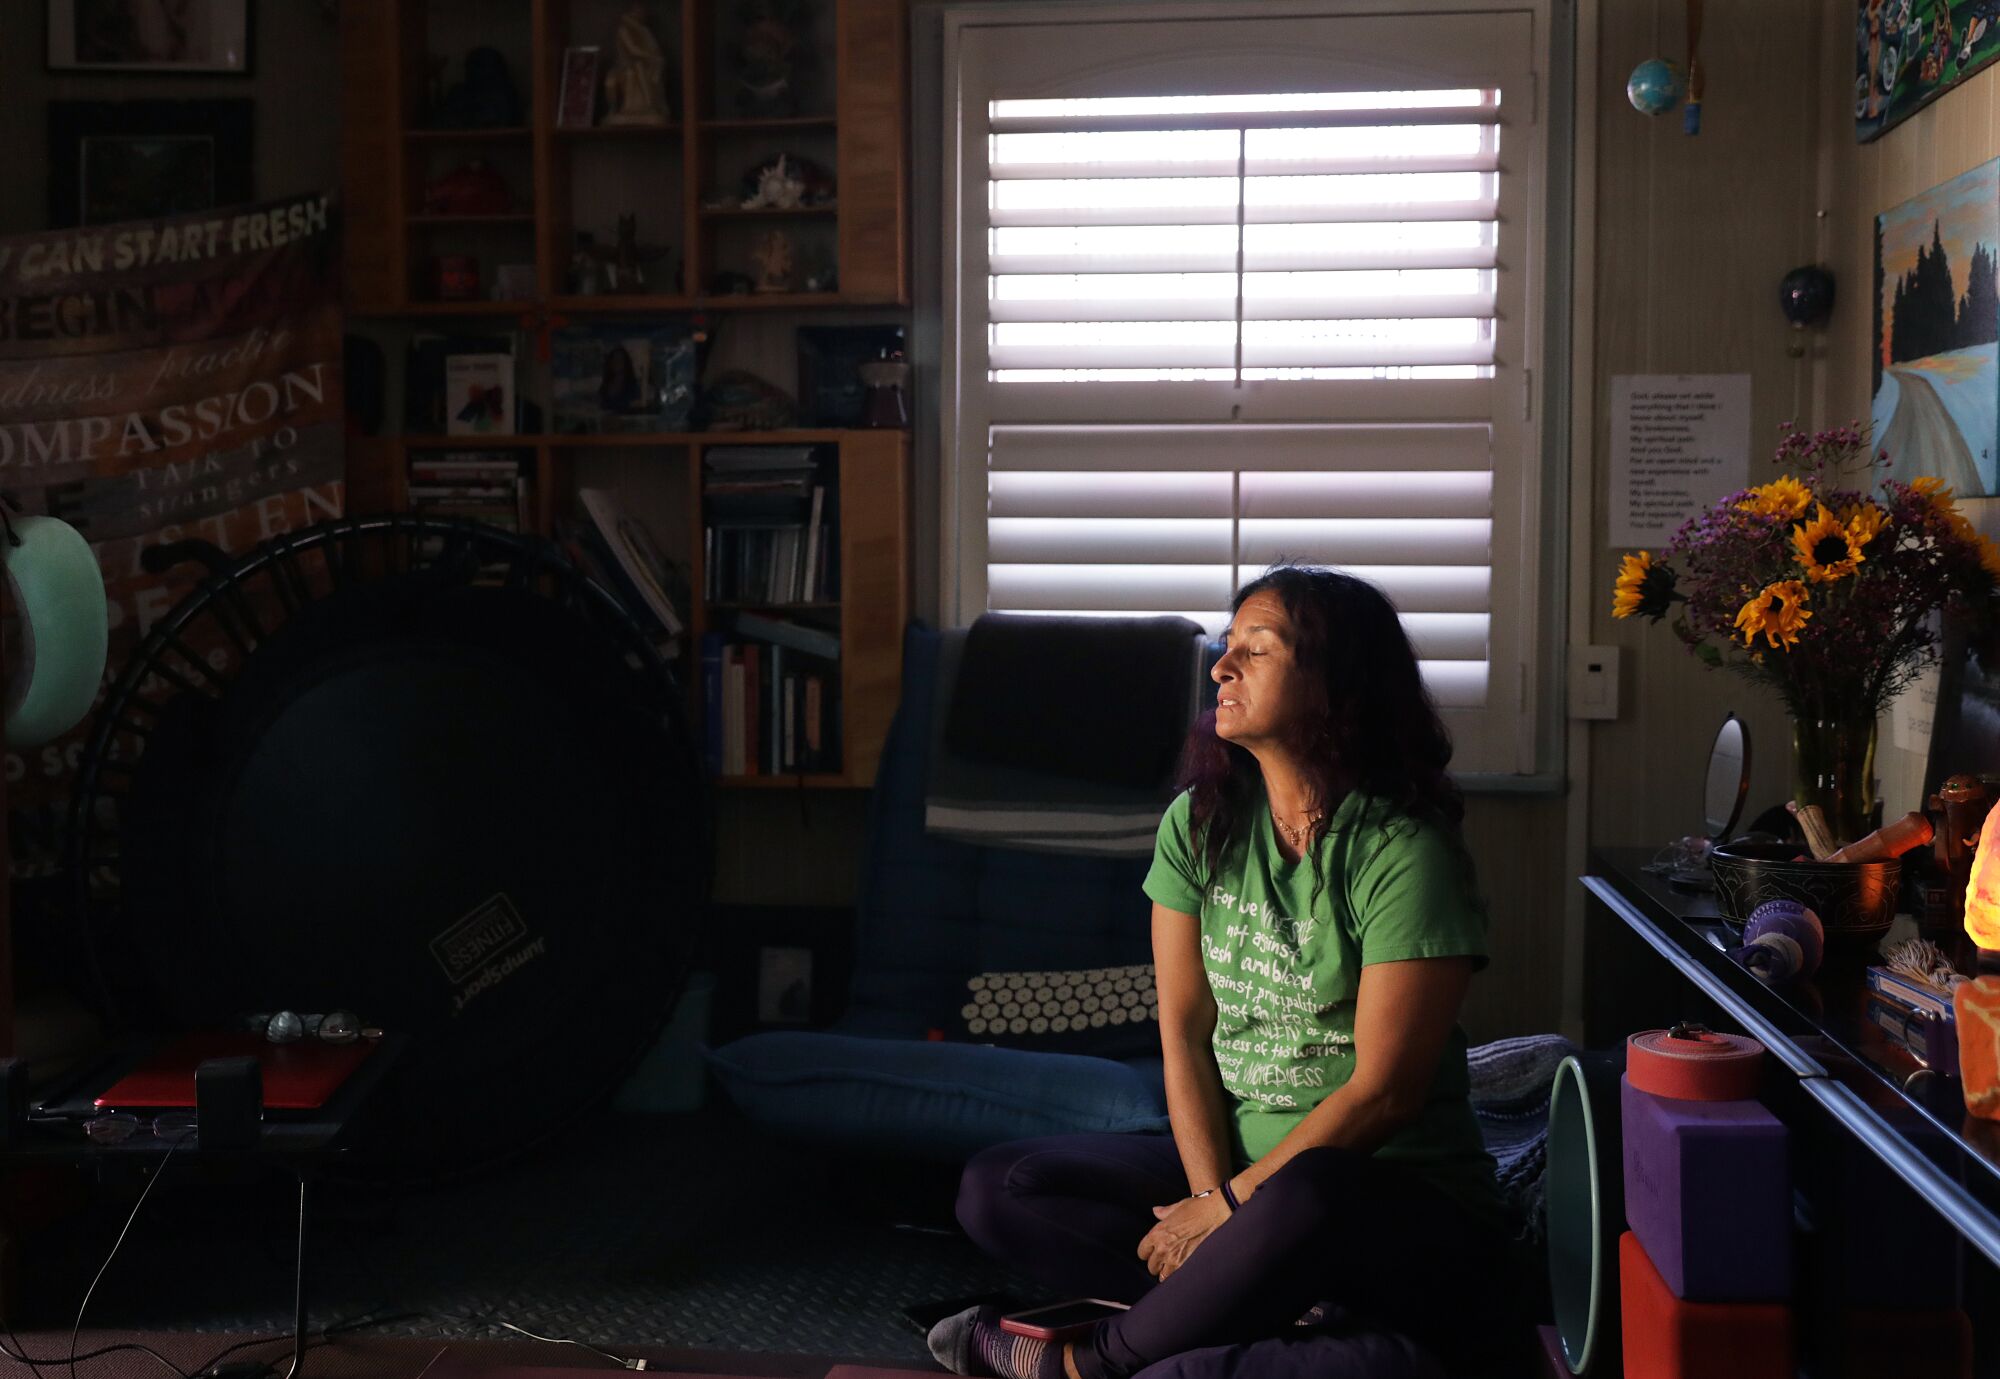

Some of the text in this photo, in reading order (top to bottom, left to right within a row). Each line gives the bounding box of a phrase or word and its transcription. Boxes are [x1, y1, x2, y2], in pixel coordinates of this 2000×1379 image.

[18, 235, 104, 280] CAN
[113, 221, 223, 269] START
[231, 197, 328, 255] FRESH
[1212, 886, 1237, 910] For
[1238, 902, 1258, 917] we
[448, 908, 516, 972] FITNESS
[1227, 924, 1301, 967] not against
[451, 936, 545, 1010] JumpSport
[1208, 970, 1254, 1000] against
[1241, 956, 1270, 978] and
[1253, 1041, 1268, 1057] of
